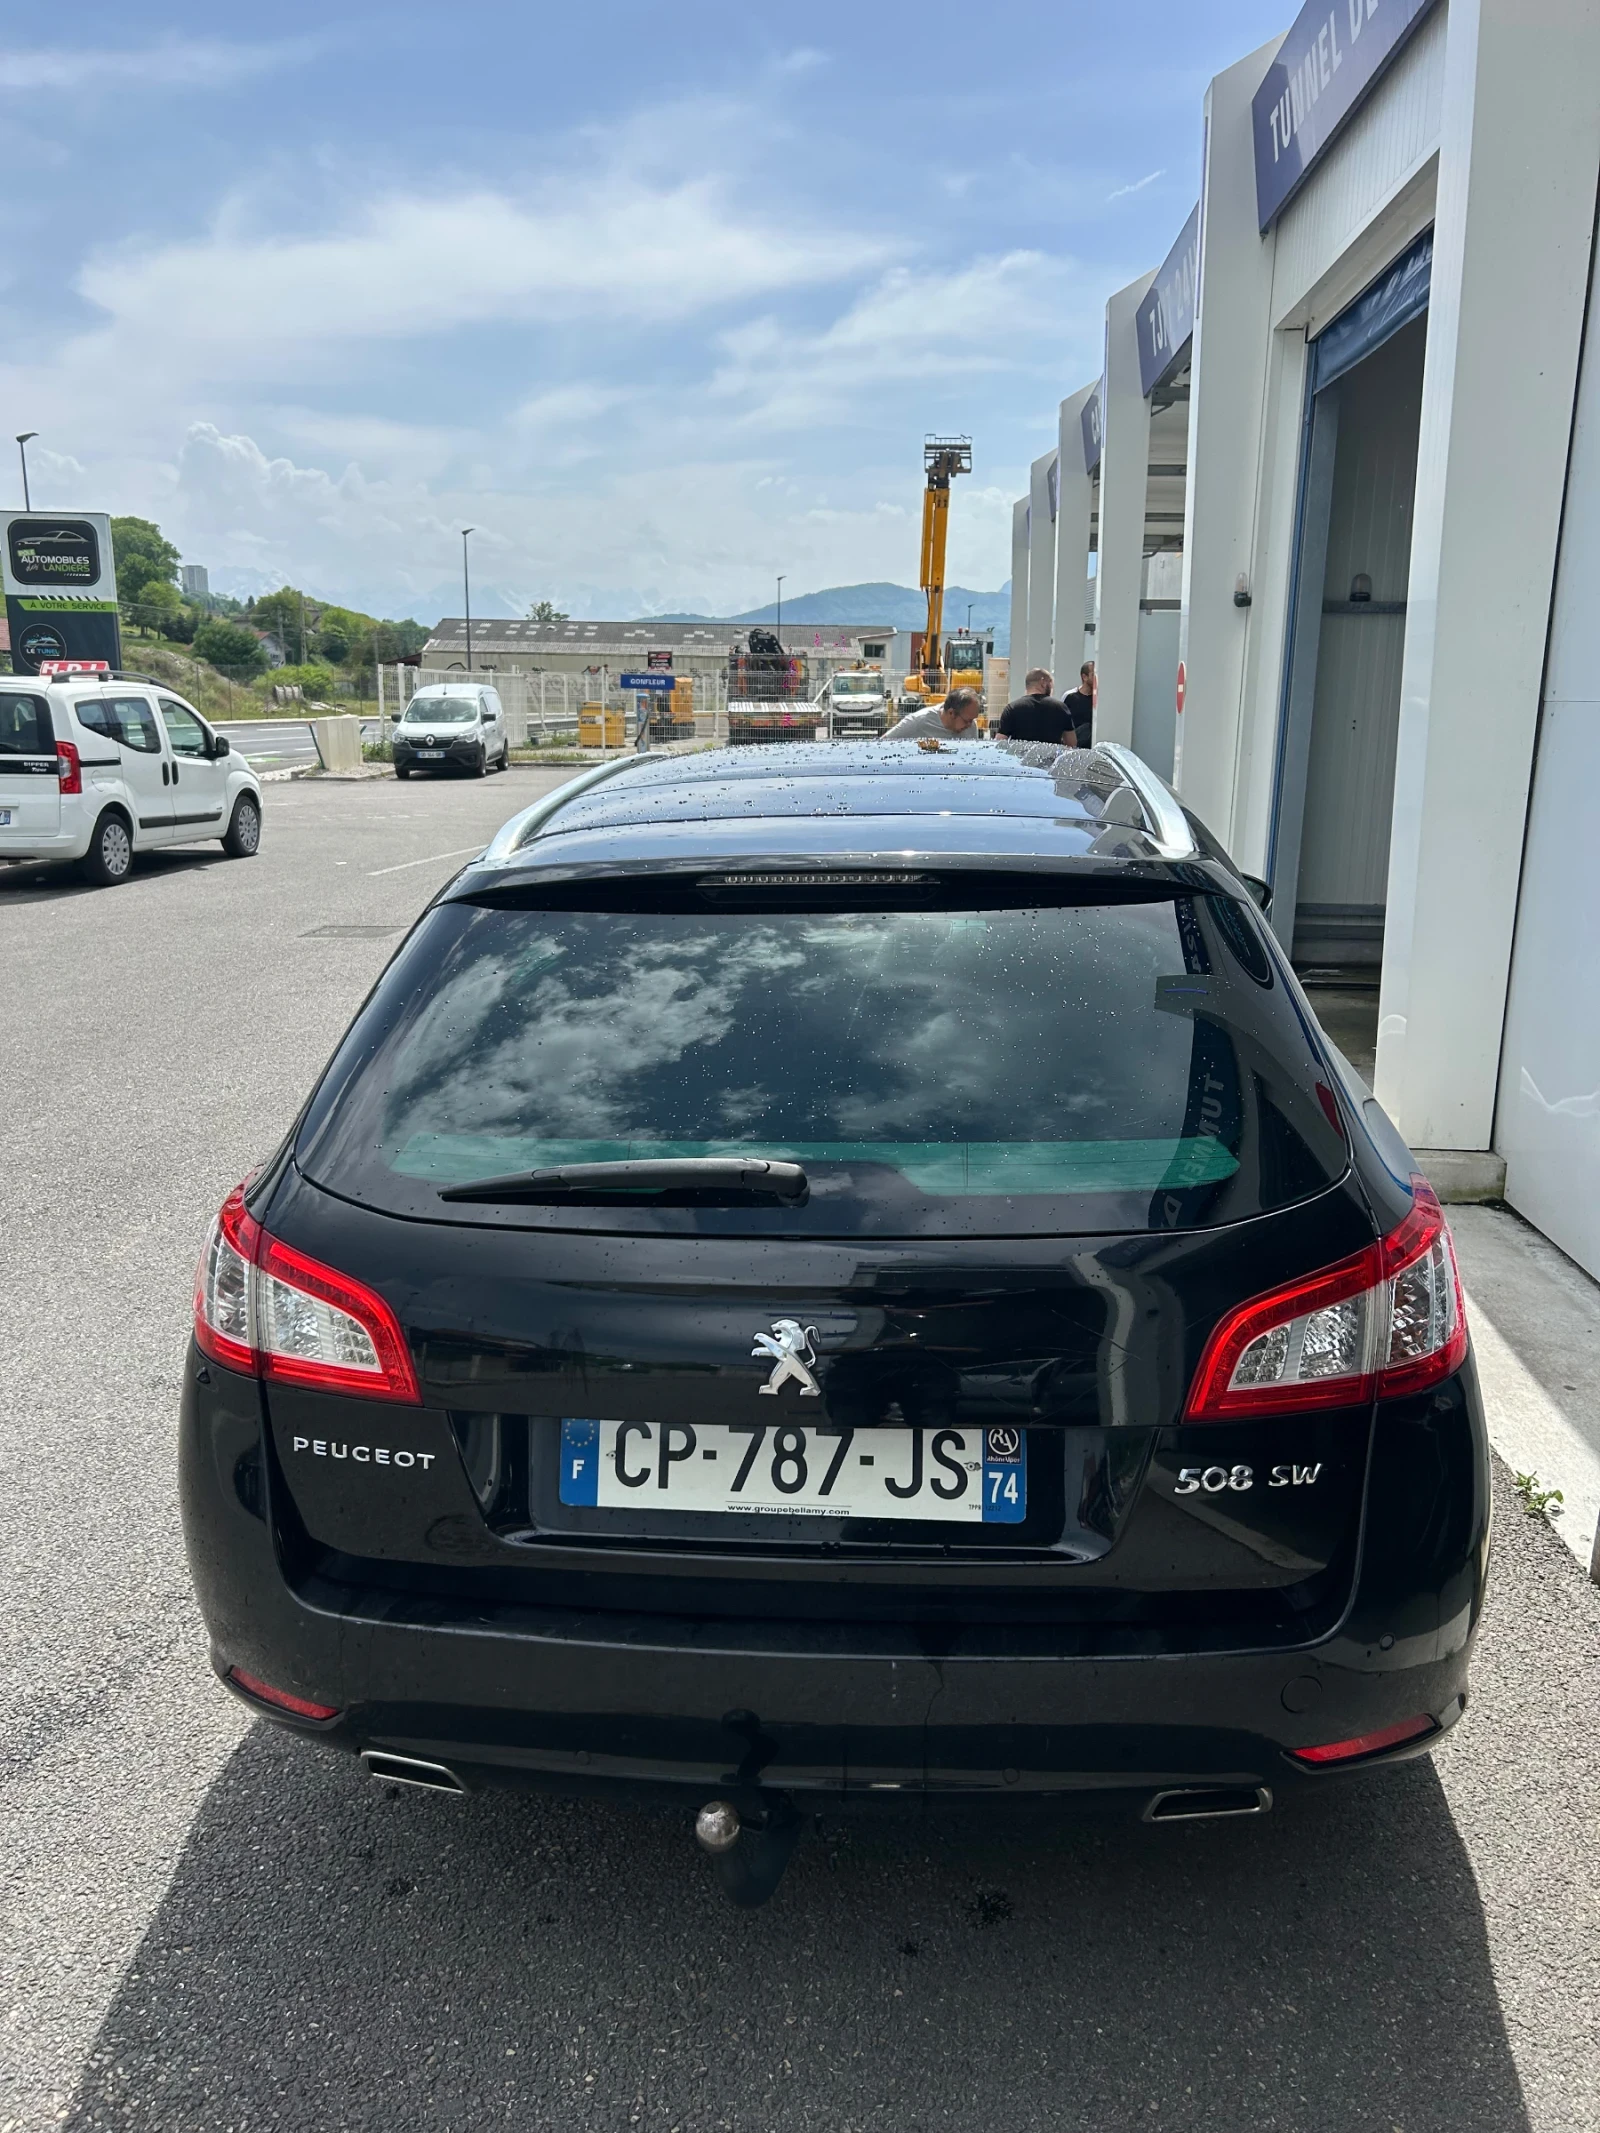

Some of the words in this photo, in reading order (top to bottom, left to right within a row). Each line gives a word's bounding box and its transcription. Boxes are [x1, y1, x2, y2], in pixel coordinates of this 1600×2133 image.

[1269, 9, 1343, 164] TUNNEL
[21, 555, 90, 565] AUTOMOBILES
[42, 564, 90, 573] LANDIERS
[40, 602, 68, 610] VOTRE
[71, 603, 107, 611] SERVICE
[630, 678, 666, 686] GONFLEUR
[293, 1436, 436, 1470] PEUGEOT
[614, 1420, 969, 1500] CP-787-JS
[572, 1459, 585, 1479] F
[1174, 1464, 1254, 1494] 508
[1267, 1462, 1323, 1487] SW
[988, 1471, 1019, 1505] 74
[727, 1504, 851, 1516] www.groupebellamy.com
